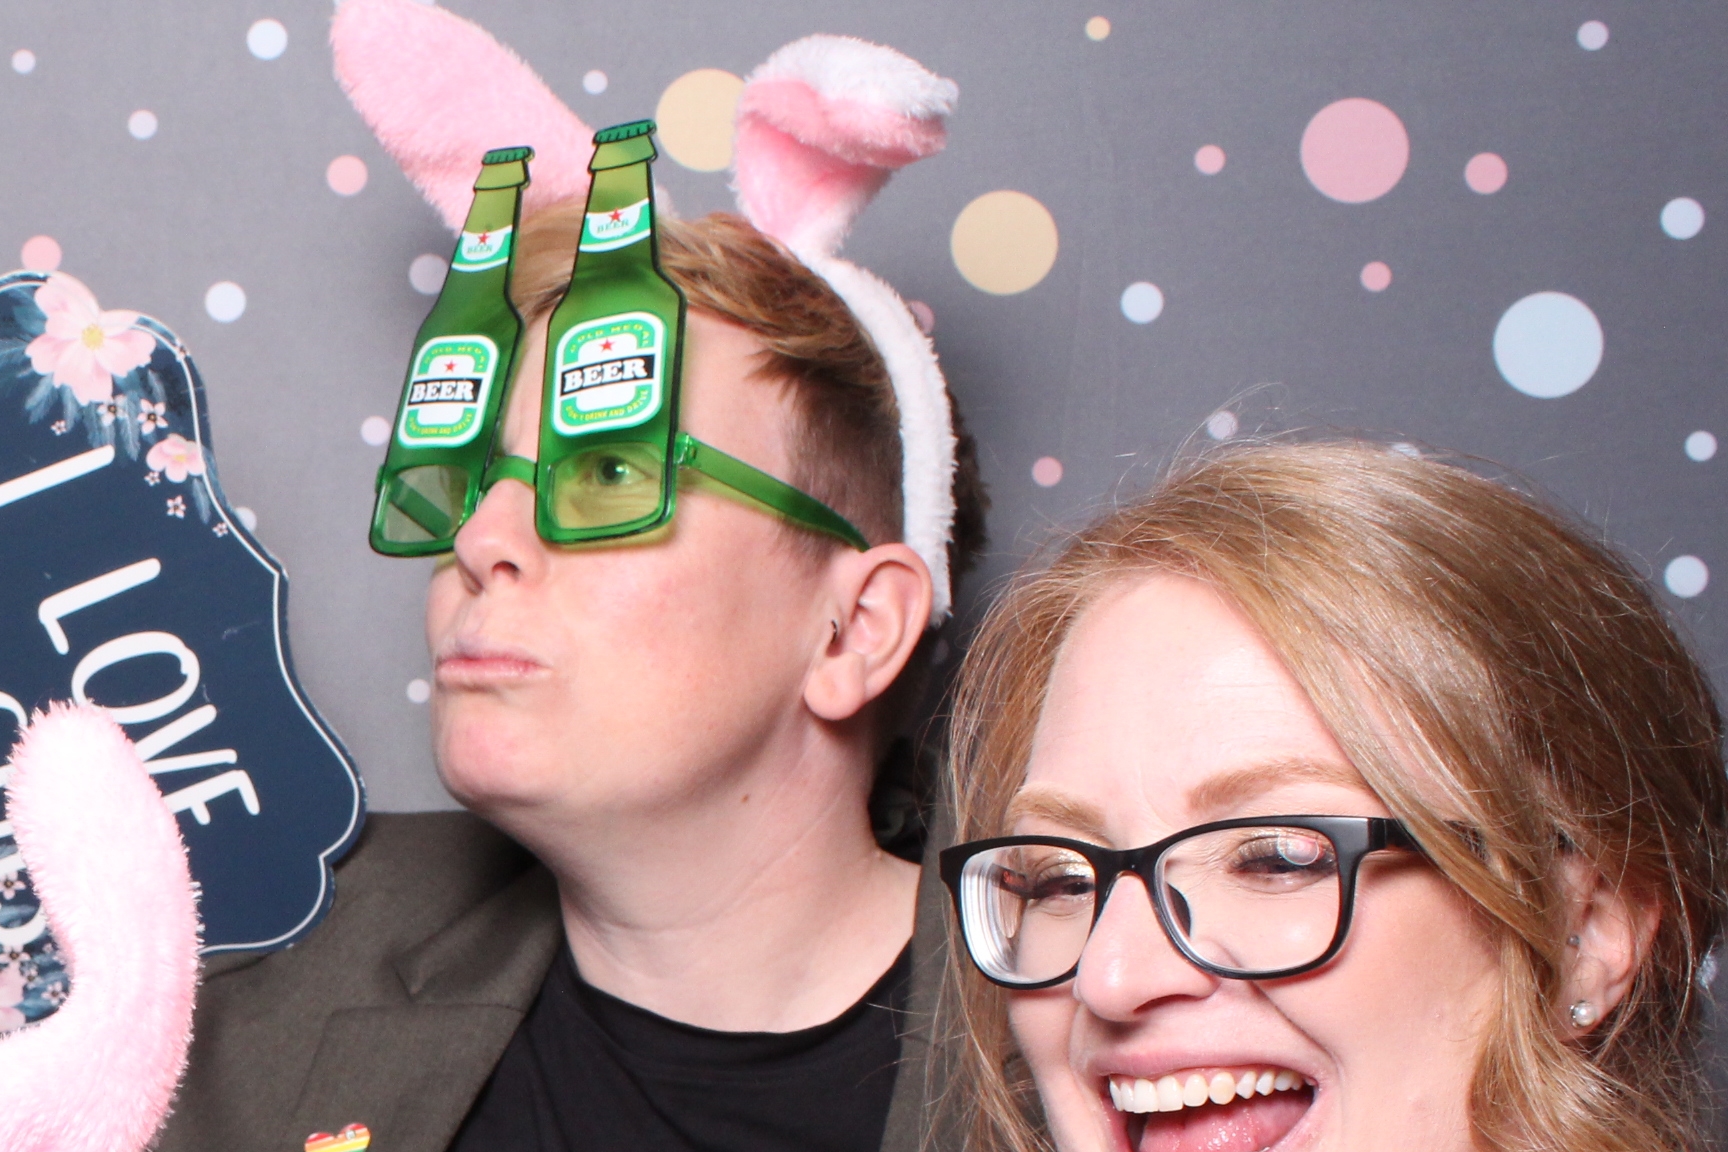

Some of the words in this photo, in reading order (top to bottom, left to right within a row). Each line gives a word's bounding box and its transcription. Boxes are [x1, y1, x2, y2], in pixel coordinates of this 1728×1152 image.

[596, 218, 630, 234] BEER
[466, 244, 493, 255] BEER
[562, 357, 648, 393] BEER
[410, 380, 475, 403] BEER
[38, 557, 260, 826] LOVE
